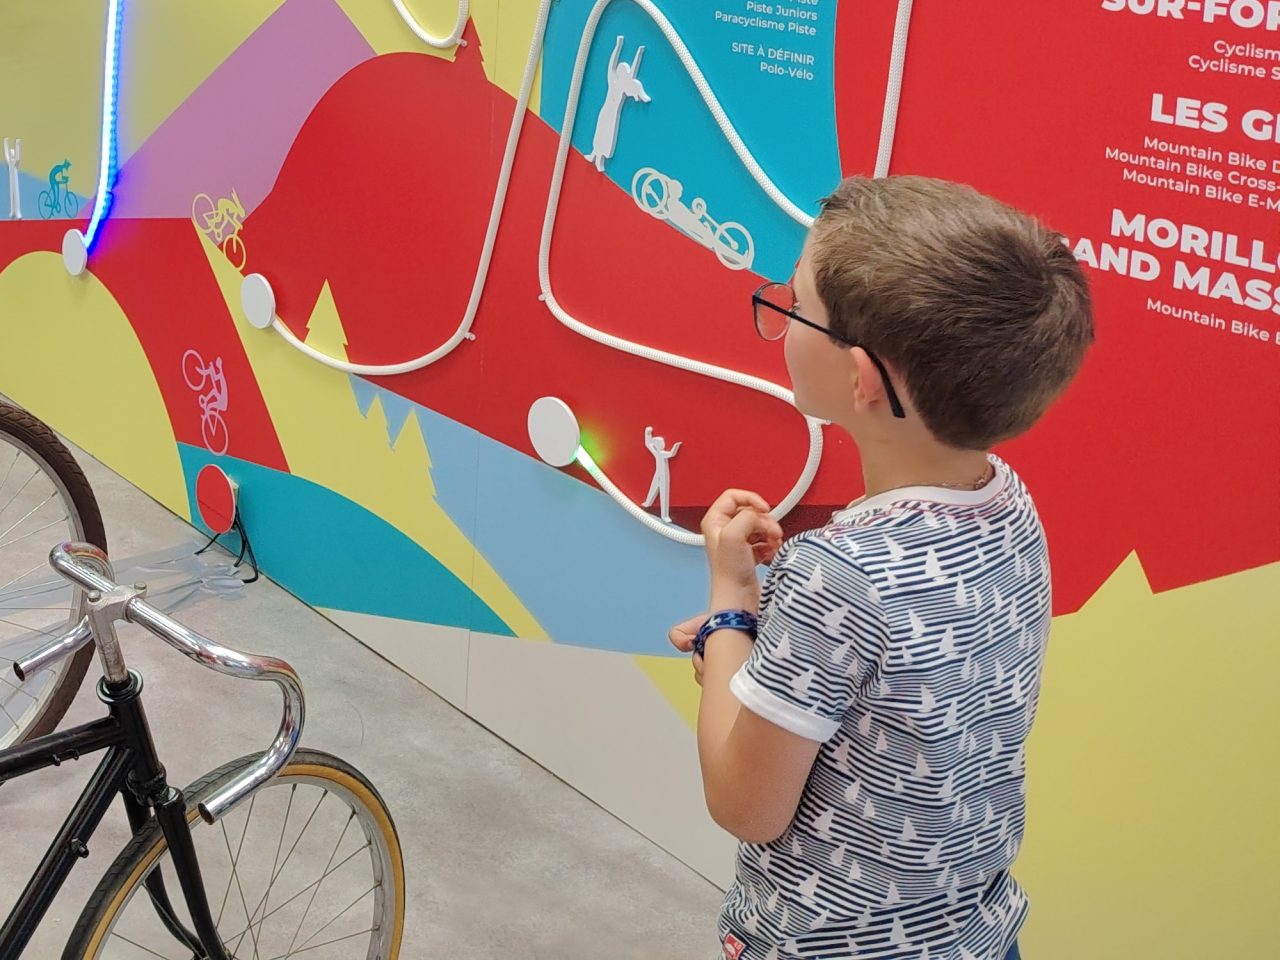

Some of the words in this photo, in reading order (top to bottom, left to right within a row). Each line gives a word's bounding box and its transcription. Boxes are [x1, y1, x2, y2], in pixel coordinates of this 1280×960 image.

[715, 11, 785, 32] Paracyclisme
[788, 21, 817, 36] Piste
[746, 1, 773, 15] Piste
[775, 4, 818, 21] Juniors
[731, 42, 755, 56] SITE
[757, 43, 766, 58] À
[767, 46, 815, 66] DÉFINIR
[1188, 55, 1266, 78] Cyclisme
[1214, 40, 1280, 61] Cyclism
[760, 61, 814, 81] Polo-Vélo
[1151, 93, 1228, 133] LES
[1241, 109, 1280, 144] G
[1105, 147, 1181, 173] Mountain
[1186, 163, 1223, 181] Bike
[1143, 136, 1222, 163] Mountain
[1228, 152, 1267, 171] Bike
[1123, 168, 1200, 195] Mountain
[1205, 185, 1243, 204] Bike
[1248, 194, 1280, 213] E-M
[1110, 208, 1280, 274] MORILL
[1061, 237, 1161, 282] AND
[1146, 297, 1226, 330] Mountain
[1231, 320, 1270, 342] Bike
